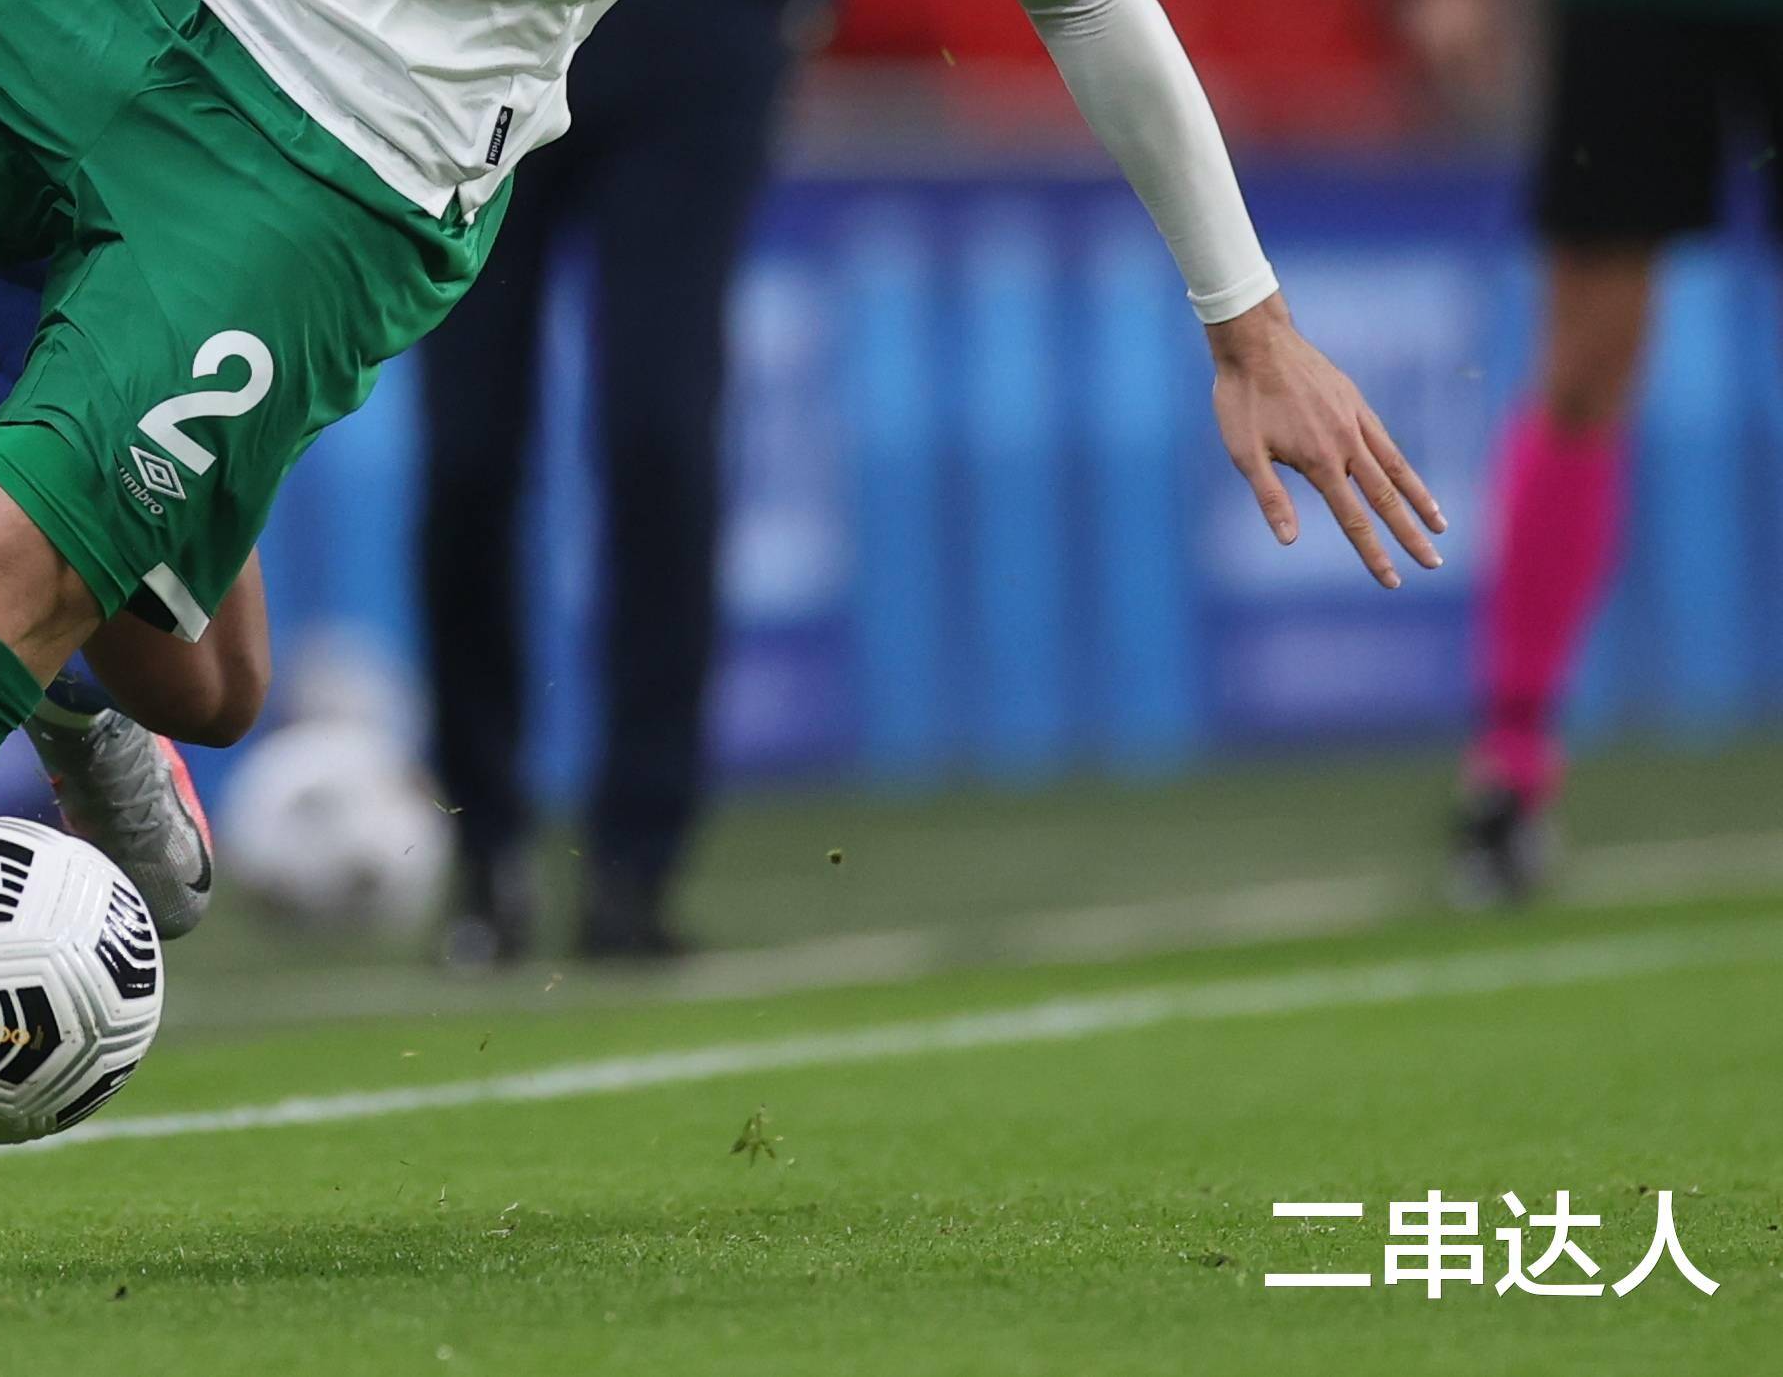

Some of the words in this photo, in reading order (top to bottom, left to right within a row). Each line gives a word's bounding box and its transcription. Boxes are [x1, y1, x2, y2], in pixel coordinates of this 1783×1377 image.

[489, 127, 503, 162] official
[137, 329, 274, 476] 2
[119, 467, 164, 514] umbro
